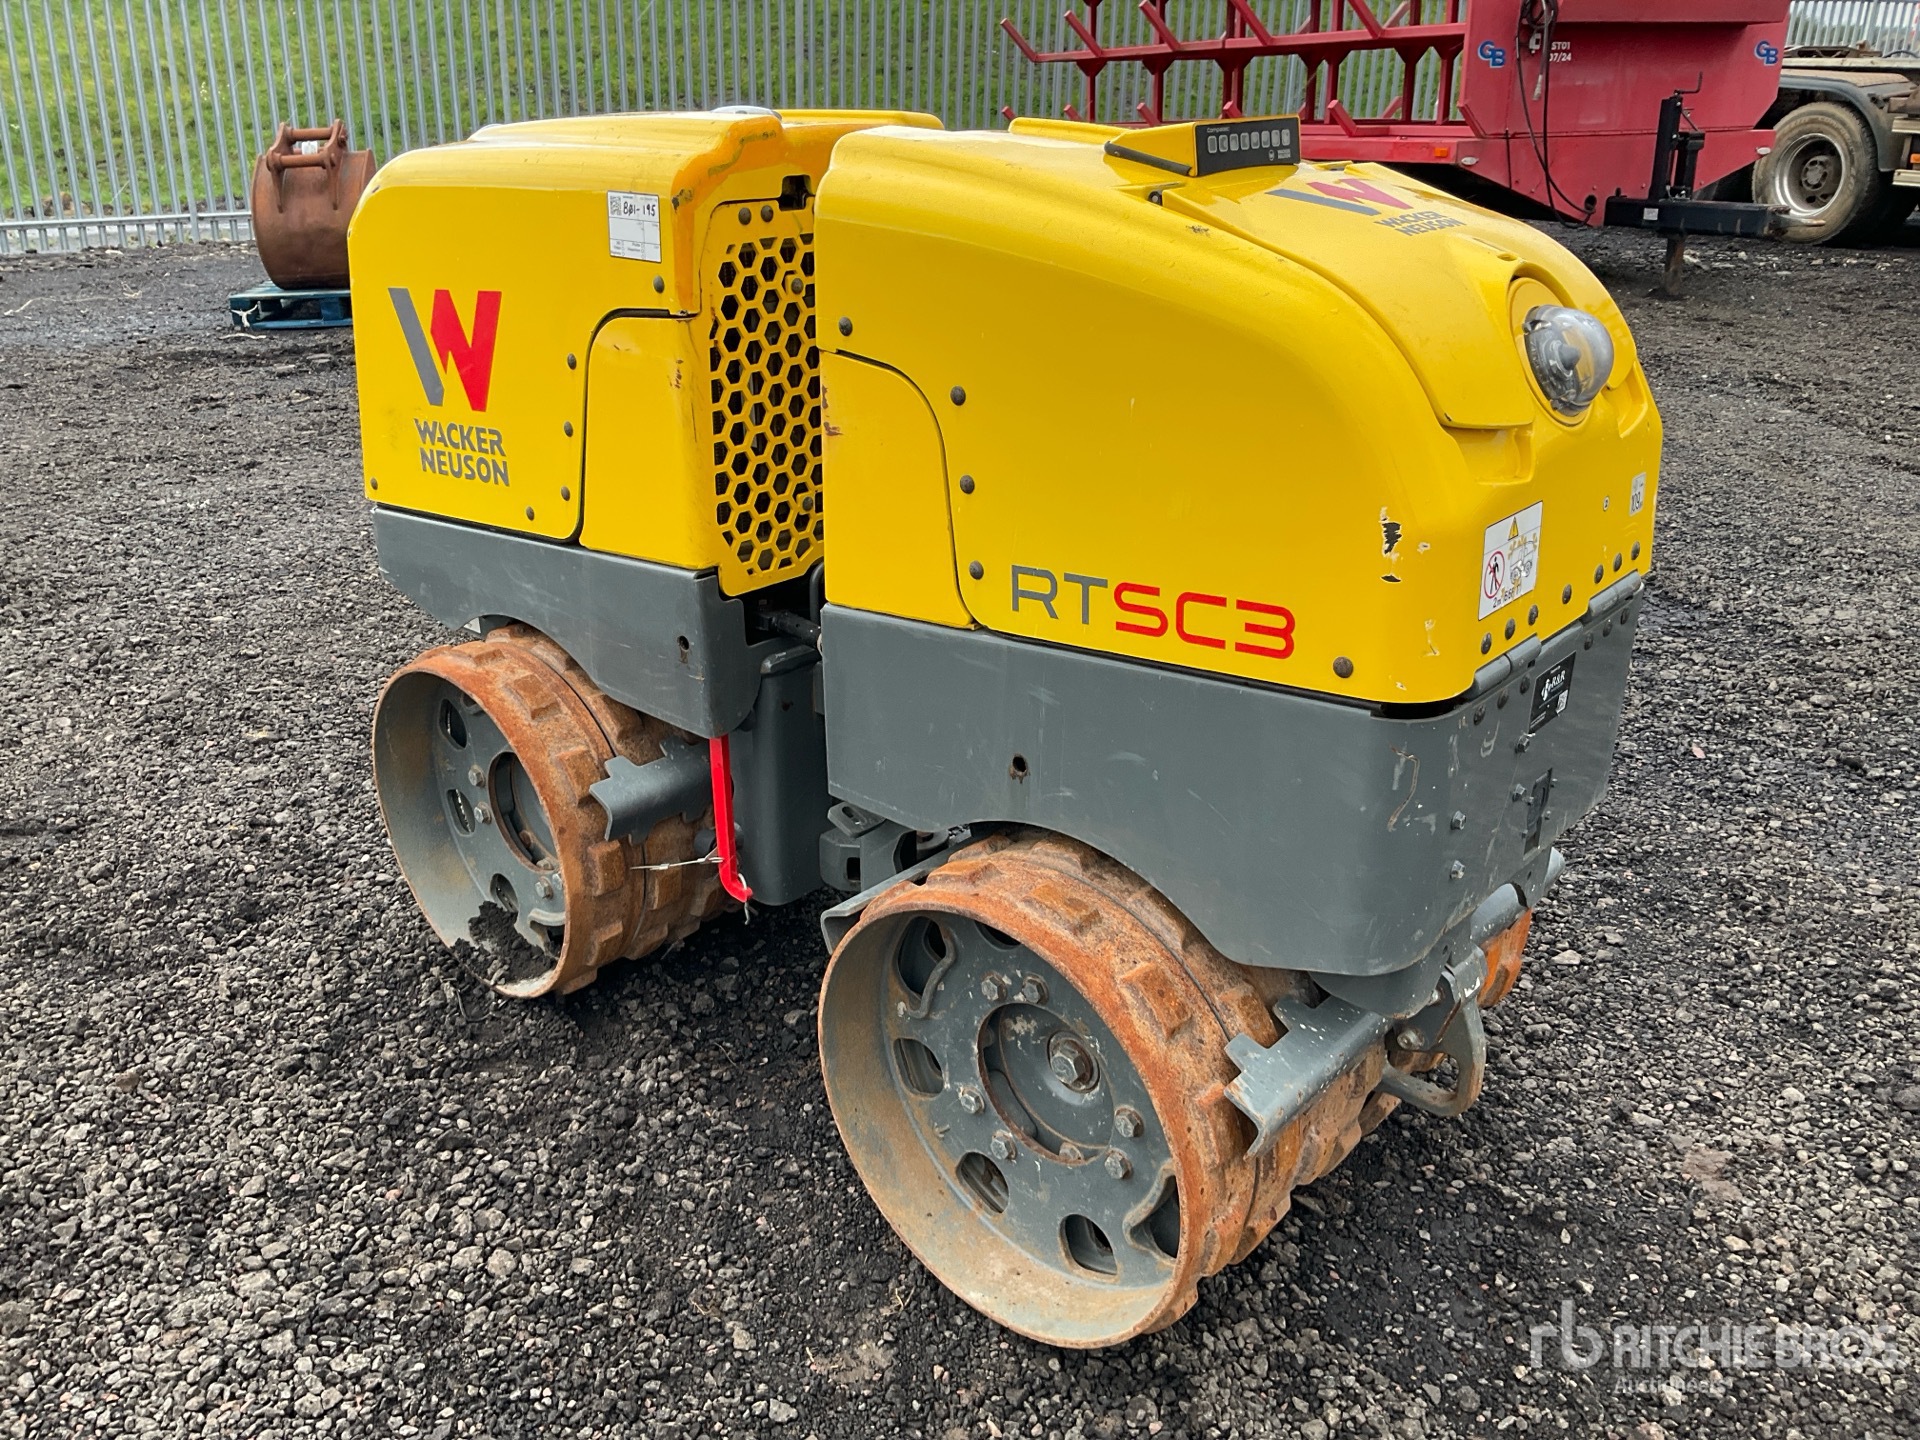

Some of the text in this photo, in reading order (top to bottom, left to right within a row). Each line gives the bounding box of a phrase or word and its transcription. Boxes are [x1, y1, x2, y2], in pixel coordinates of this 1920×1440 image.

[1551, 41, 1571, 51] ST01
[1373, 210, 1448, 228] WACKER
[1395, 217, 1468, 237] NEUSON
[414, 418, 507, 457] WACKER
[419, 447, 510, 488] NEUSON
[1011, 564, 1296, 660] RTSC3
